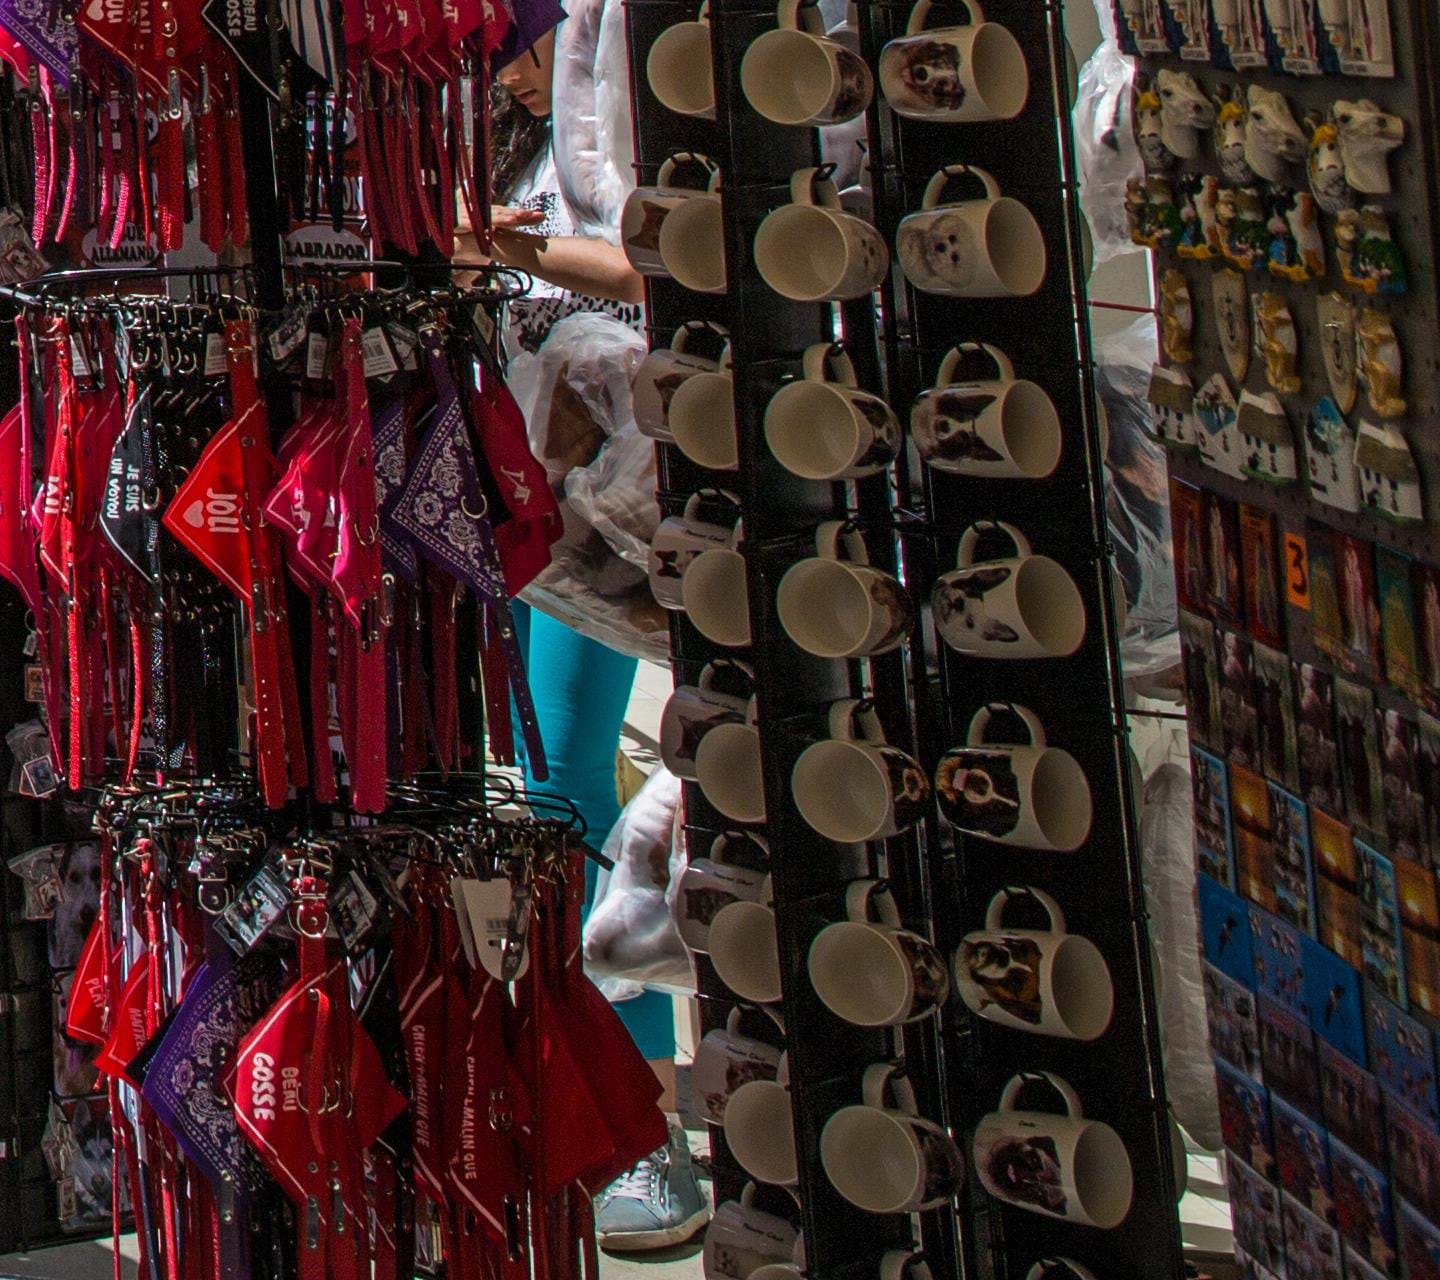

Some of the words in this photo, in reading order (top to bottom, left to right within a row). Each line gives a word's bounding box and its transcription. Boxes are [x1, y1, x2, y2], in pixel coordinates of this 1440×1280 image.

[283, 241, 366, 260] LABRADOR
[125, 464, 141, 481] JE
[124, 483, 141, 513] SUIS
[251, 1051, 277, 1121] GOSSE
